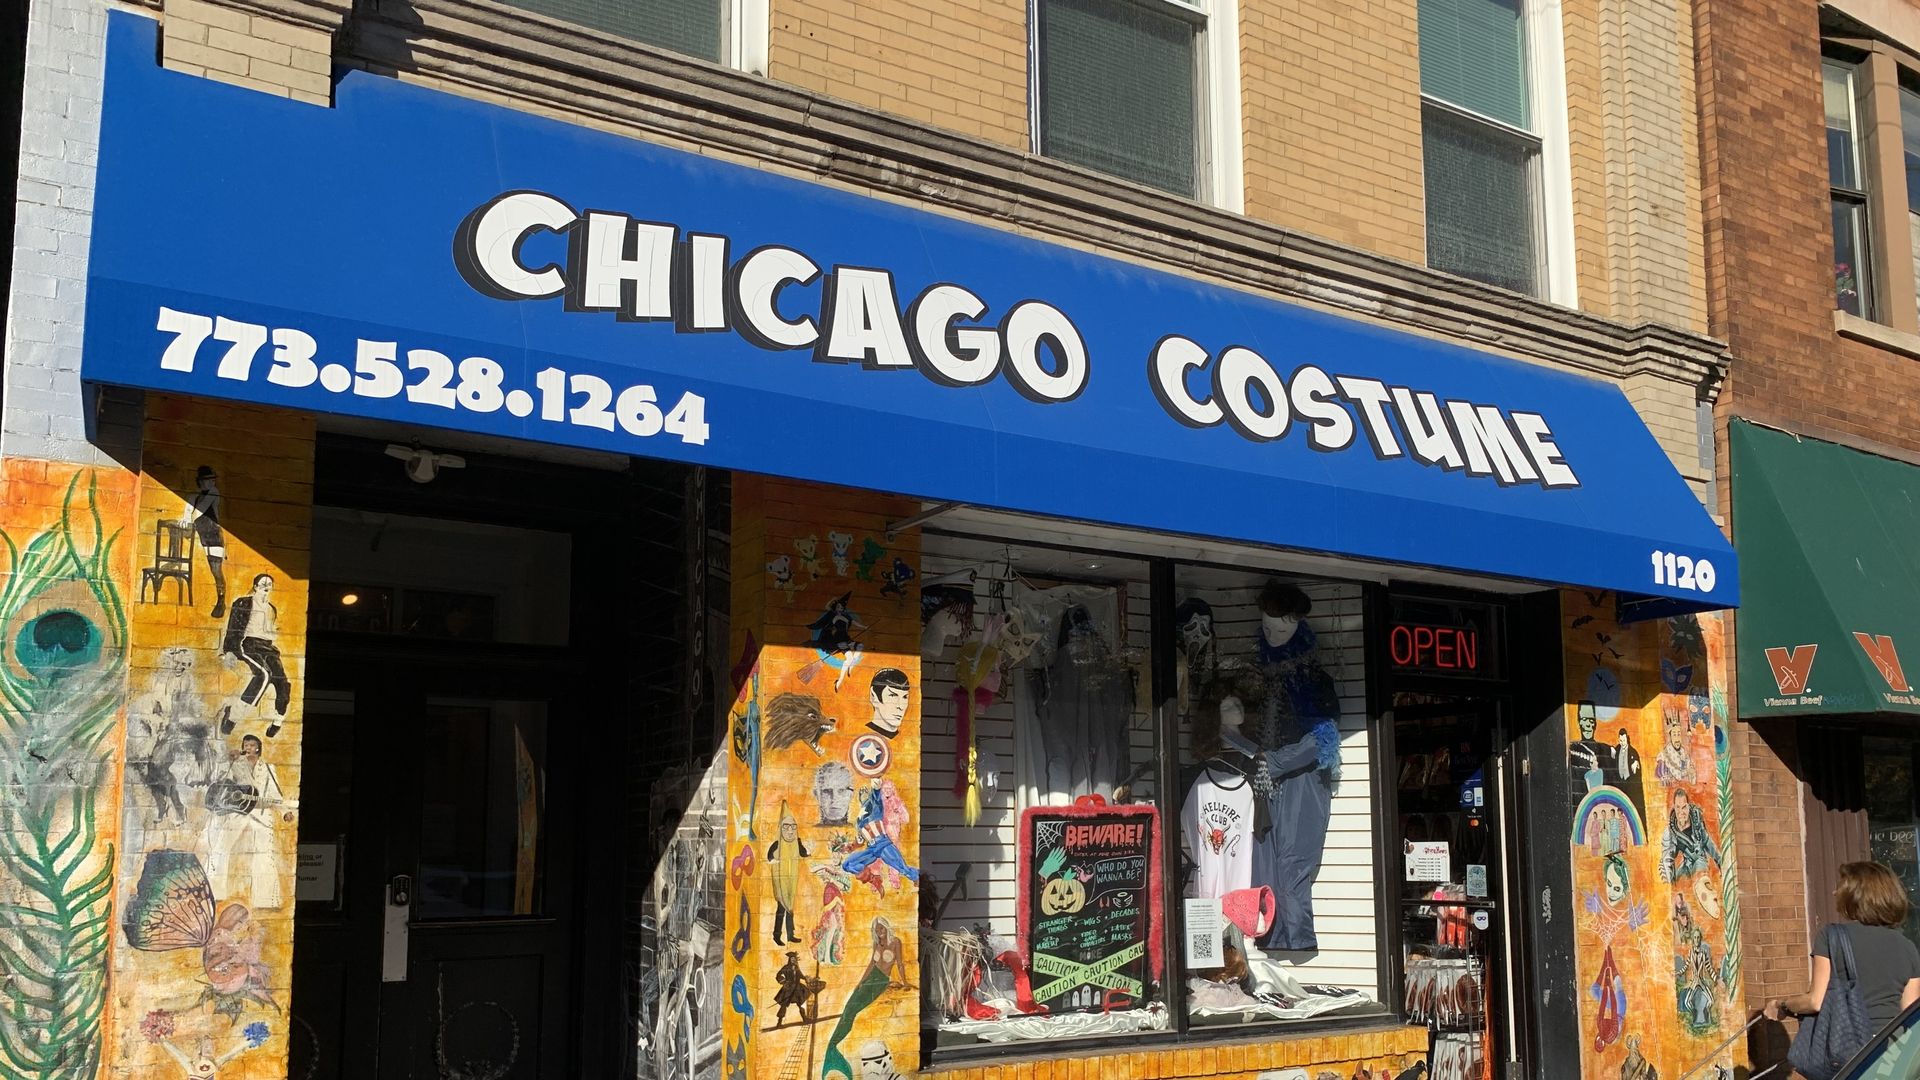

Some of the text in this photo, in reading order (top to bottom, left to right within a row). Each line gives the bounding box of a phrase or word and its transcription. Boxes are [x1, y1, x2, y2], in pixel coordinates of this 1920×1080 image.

[458, 192, 1580, 486] CHICAGO COSTUME
[157, 307, 710, 446] 773.528.1264
[1651, 551, 1716, 593] 1120
[1389, 625, 1475, 670] OPEN
[1764, 698, 1797, 706] Vienna
[1800, 695, 1823, 705] Beef
[1882, 693, 1909, 704] Vienna
[1211, 813, 1228, 826] CLUB
[1065, 823, 1144, 849] BEWARE!
[1097, 859, 1145, 873] WHO DO YOU
[1096, 868, 1142, 884] WANNA BE?
[1110, 907, 1140, 919] DECADES
[1038, 916, 1073, 930] STRANGER
[1083, 915, 1101, 926] WIGS
[1111, 933, 1132, 941] MASKS
[1079, 948, 1103, 961] MORE
[1035, 976, 1077, 1003] CAUTION
[1083, 954, 1124, 980] CAUTION
